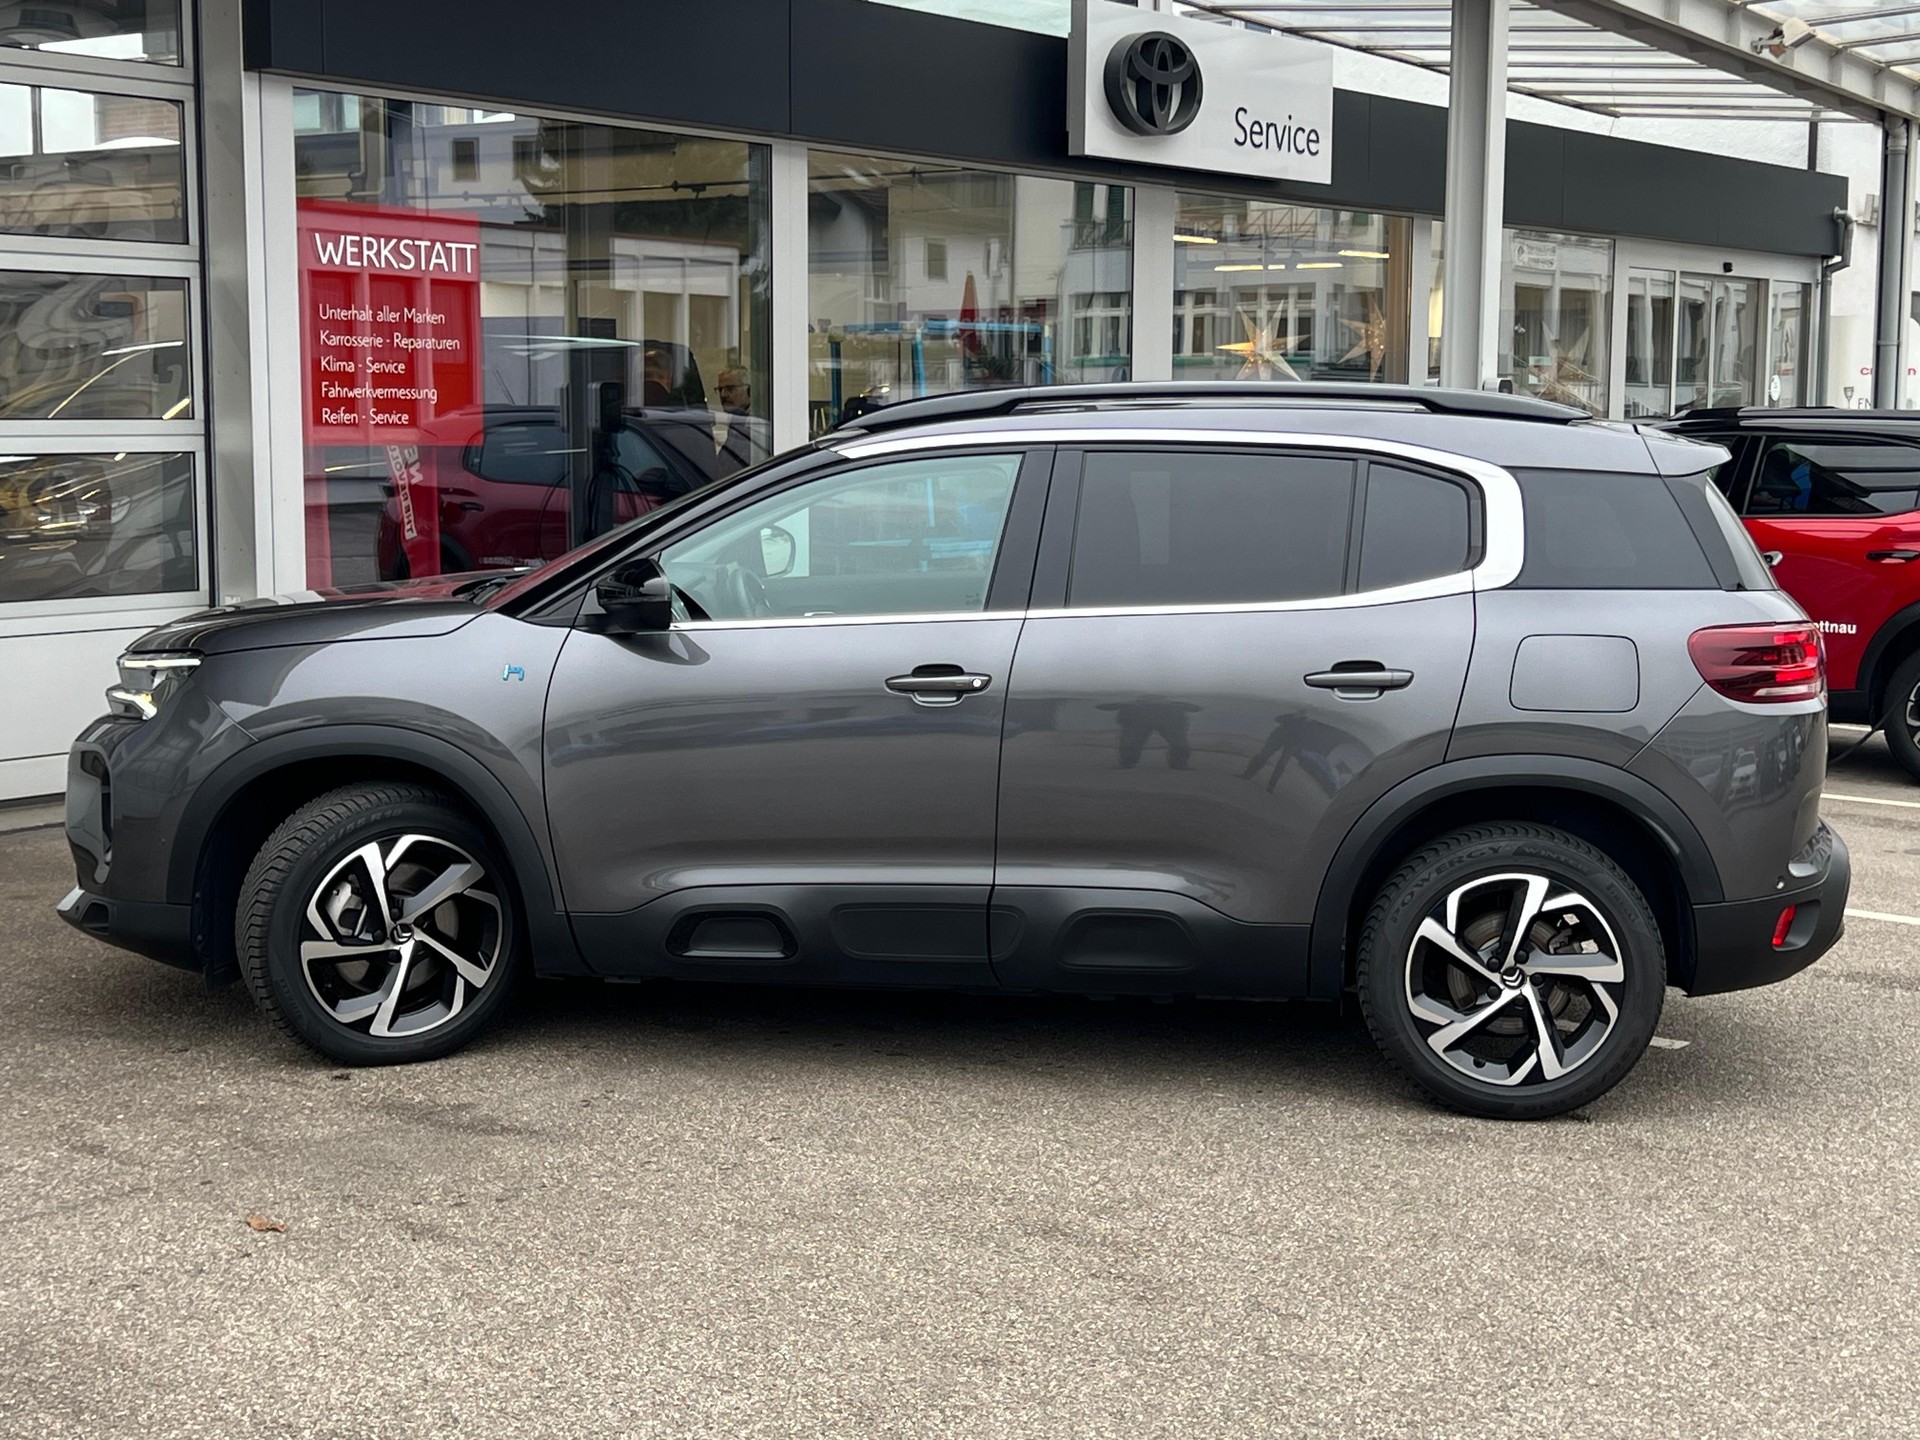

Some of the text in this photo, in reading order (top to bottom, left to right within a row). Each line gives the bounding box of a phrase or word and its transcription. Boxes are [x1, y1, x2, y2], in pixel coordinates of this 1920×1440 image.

[1234, 107, 1320, 156] Service
[314, 232, 477, 274] WERKSTATT
[319, 303, 445, 325] Unterhalt aller Marken
[320, 330, 383, 348] Karrosserie
[393, 332, 460, 352] Reparaturen
[320, 355, 355, 372] Klima
[366, 356, 406, 373] Service
[321, 380, 438, 404] Fahrwerkvermessung
[322, 406, 359, 424] Reifen
[369, 408, 409, 425] Service
